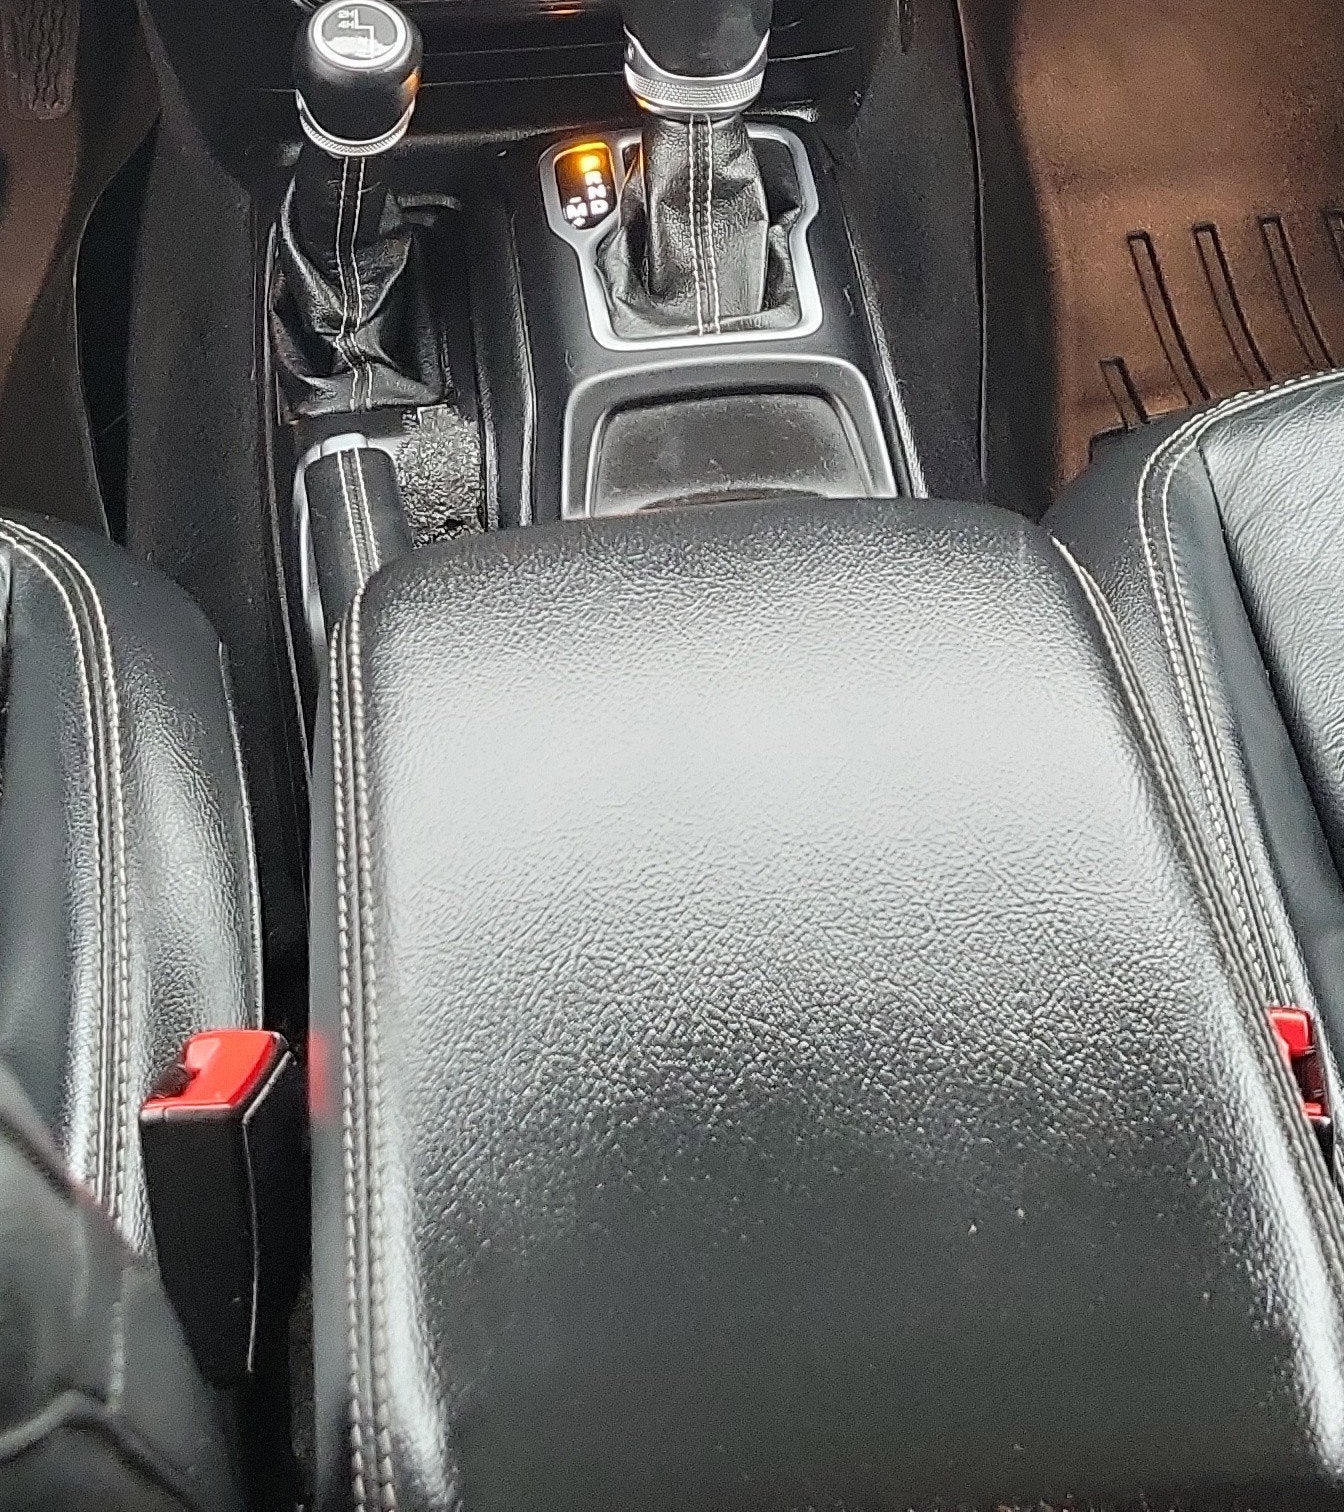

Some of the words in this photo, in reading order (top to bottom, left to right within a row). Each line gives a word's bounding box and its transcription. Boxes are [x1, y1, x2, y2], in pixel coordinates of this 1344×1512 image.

[338, 8, 355, 19] 2H
[338, 20, 355, 29] 4H
[588, 184, 607, 200] N
[566, 202, 589, 220] M
[590, 199, 609, 216] D
